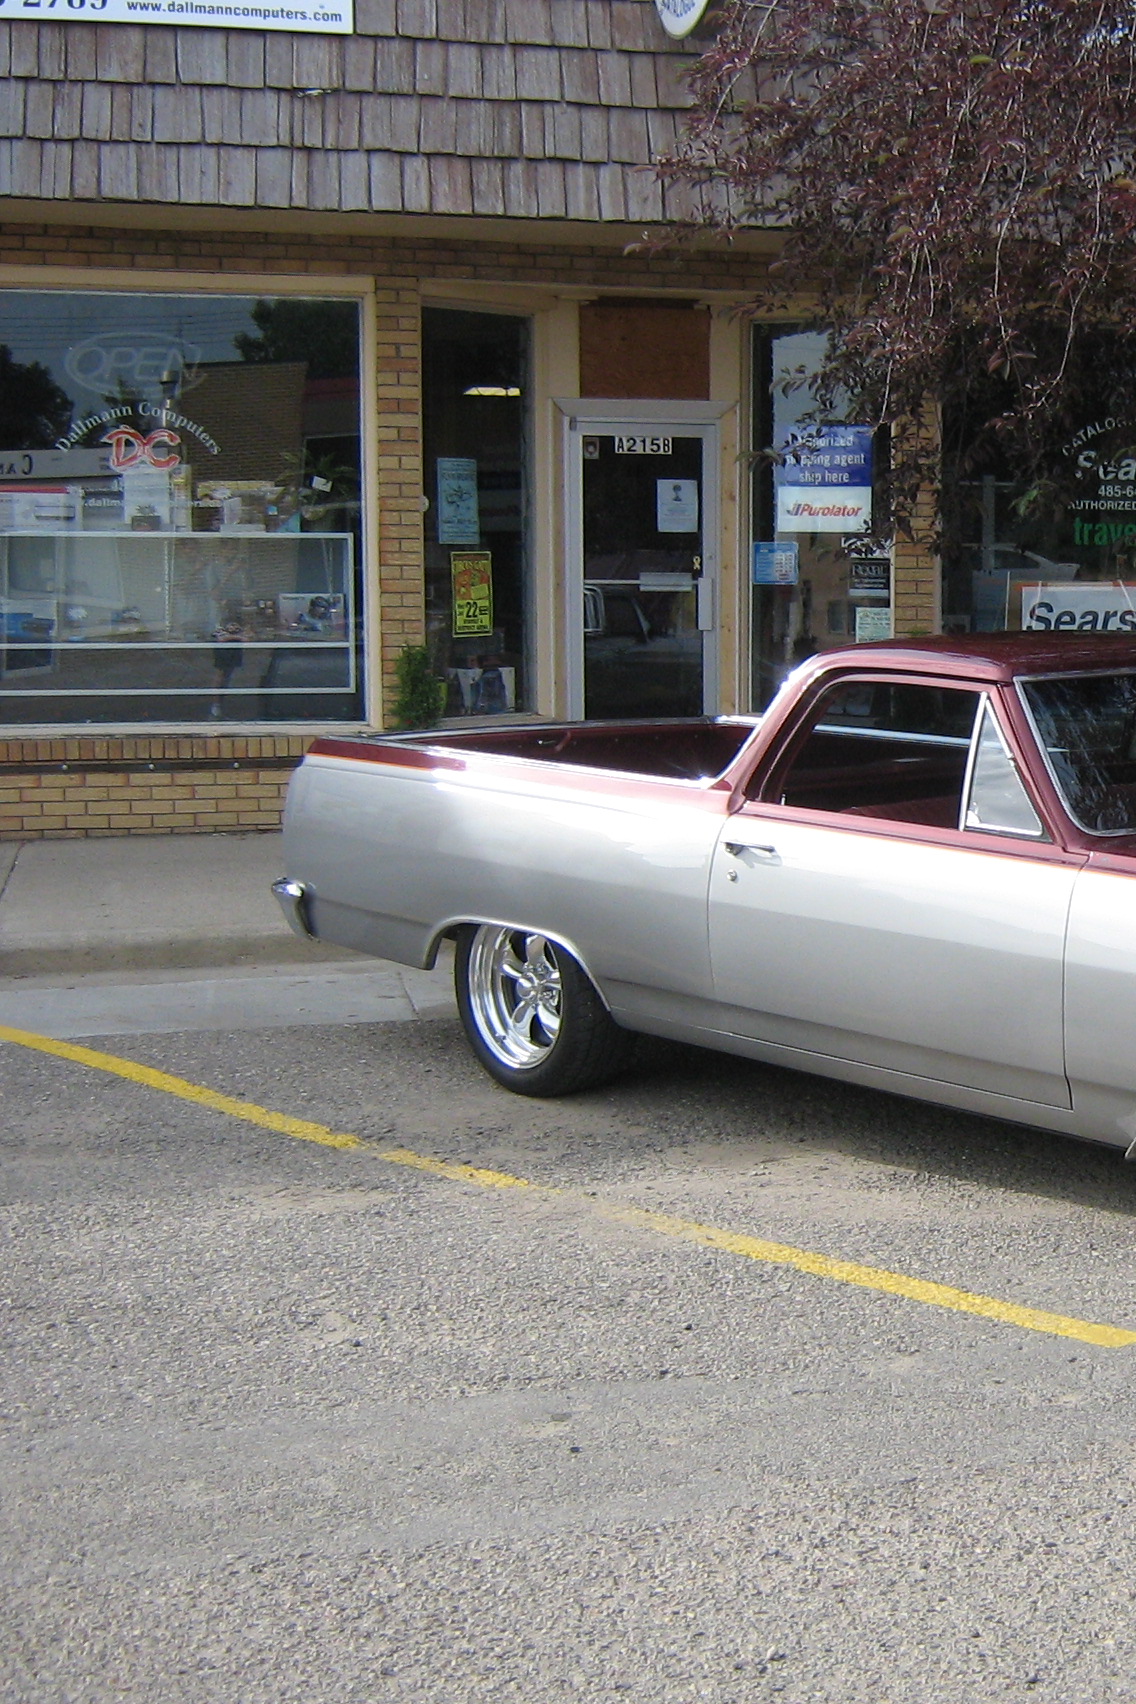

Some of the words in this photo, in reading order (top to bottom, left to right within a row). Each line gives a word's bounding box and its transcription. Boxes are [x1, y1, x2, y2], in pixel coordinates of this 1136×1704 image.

[127, 1, 342, 22] www.dallmanncomputers.com
[75, 347, 184, 386] OPEN
[55, 405, 132, 453] Dallmann
[138, 402, 222, 456] Computers
[101, 425, 181, 472] DC
[616, 437, 671, 453] A215B
[834, 453, 865, 468] agent
[799, 470, 822, 485] ship
[825, 470, 850, 483] here
[800, 503, 862, 518] Purolator
[465, 602, 478, 618] 22
